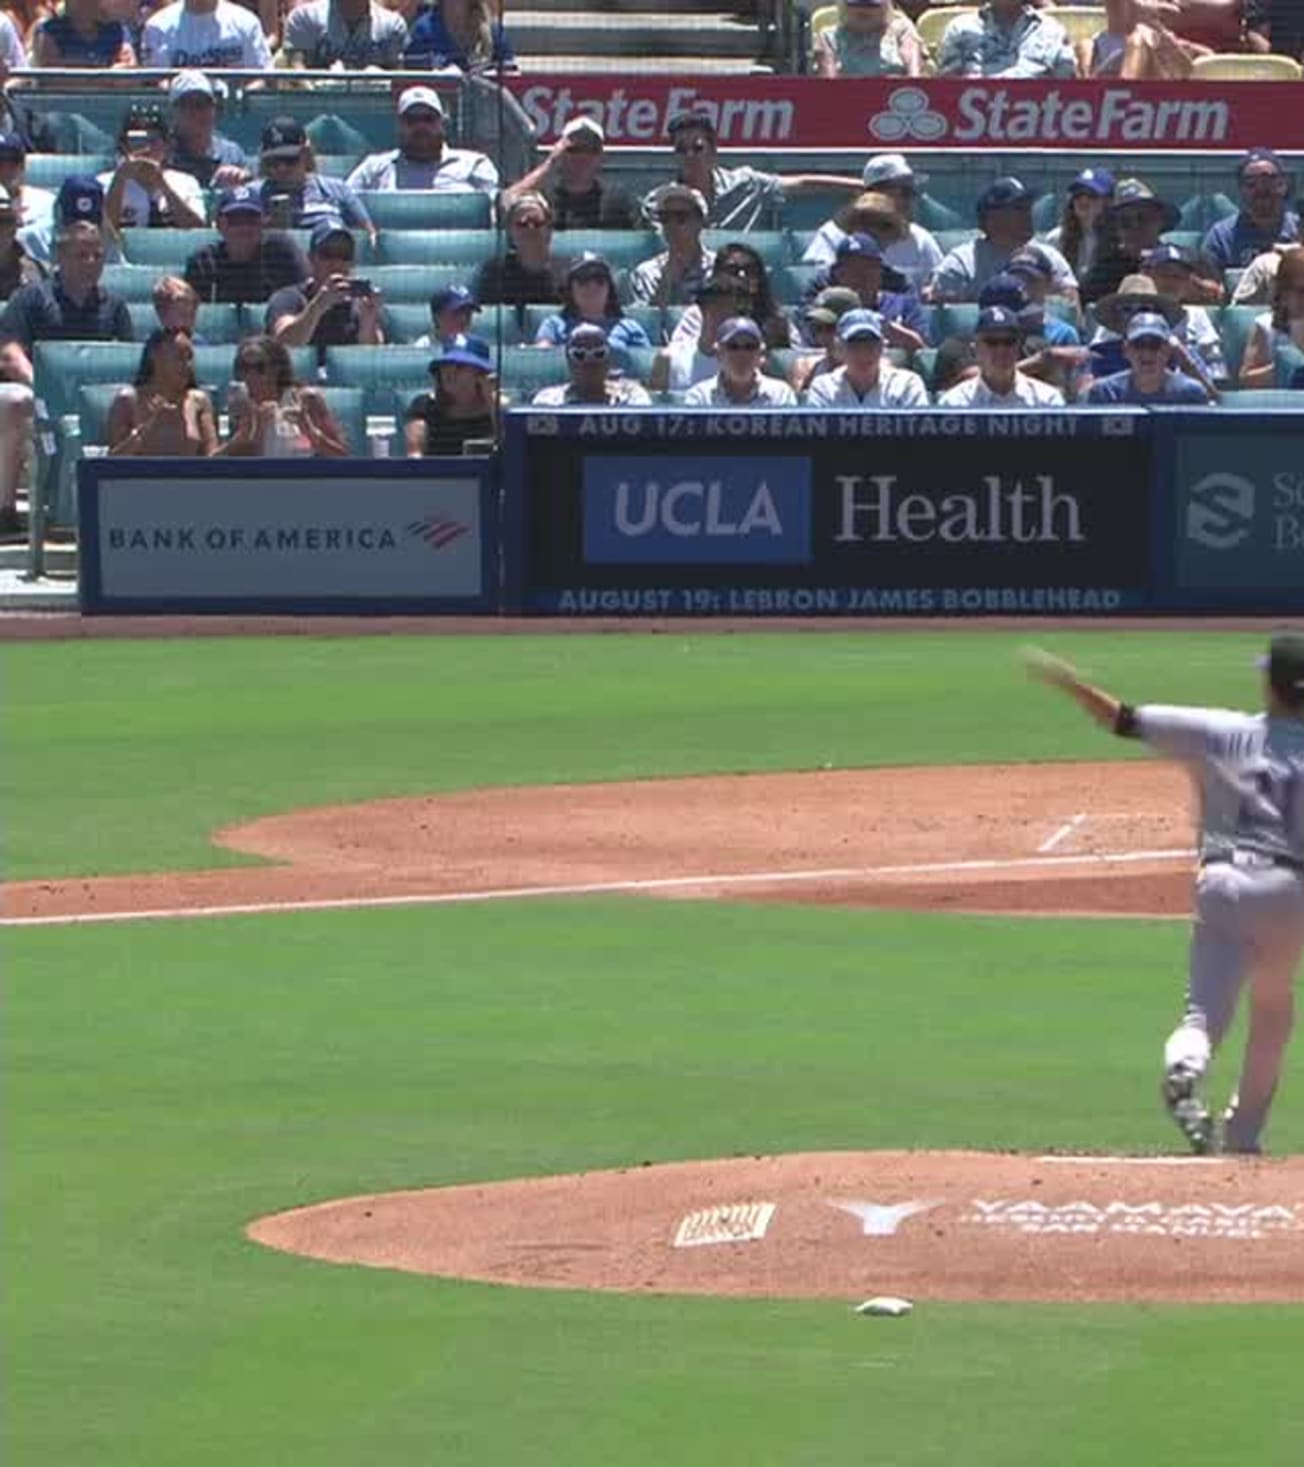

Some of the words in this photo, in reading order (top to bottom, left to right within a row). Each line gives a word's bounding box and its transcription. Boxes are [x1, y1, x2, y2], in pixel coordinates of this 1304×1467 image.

[579, 415, 640, 435] AUG
[706, 415, 826, 436] KOREAN
[839, 415, 976, 436] HERITAGE
[989, 415, 1079, 436] NIGHT
[613, 482, 783, 536] UCLA
[834, 475, 1085, 543] Health
[109, 529, 195, 550] BANK
[207, 529, 243, 550] OF
[254, 529, 397, 550] AMERICA
[558, 589, 672, 610] AUGUST
[730, 589, 836, 610] LEBRON
[849, 589, 933, 609] JAMES
[943, 589, 1120, 609] BOBBLEHEAD
